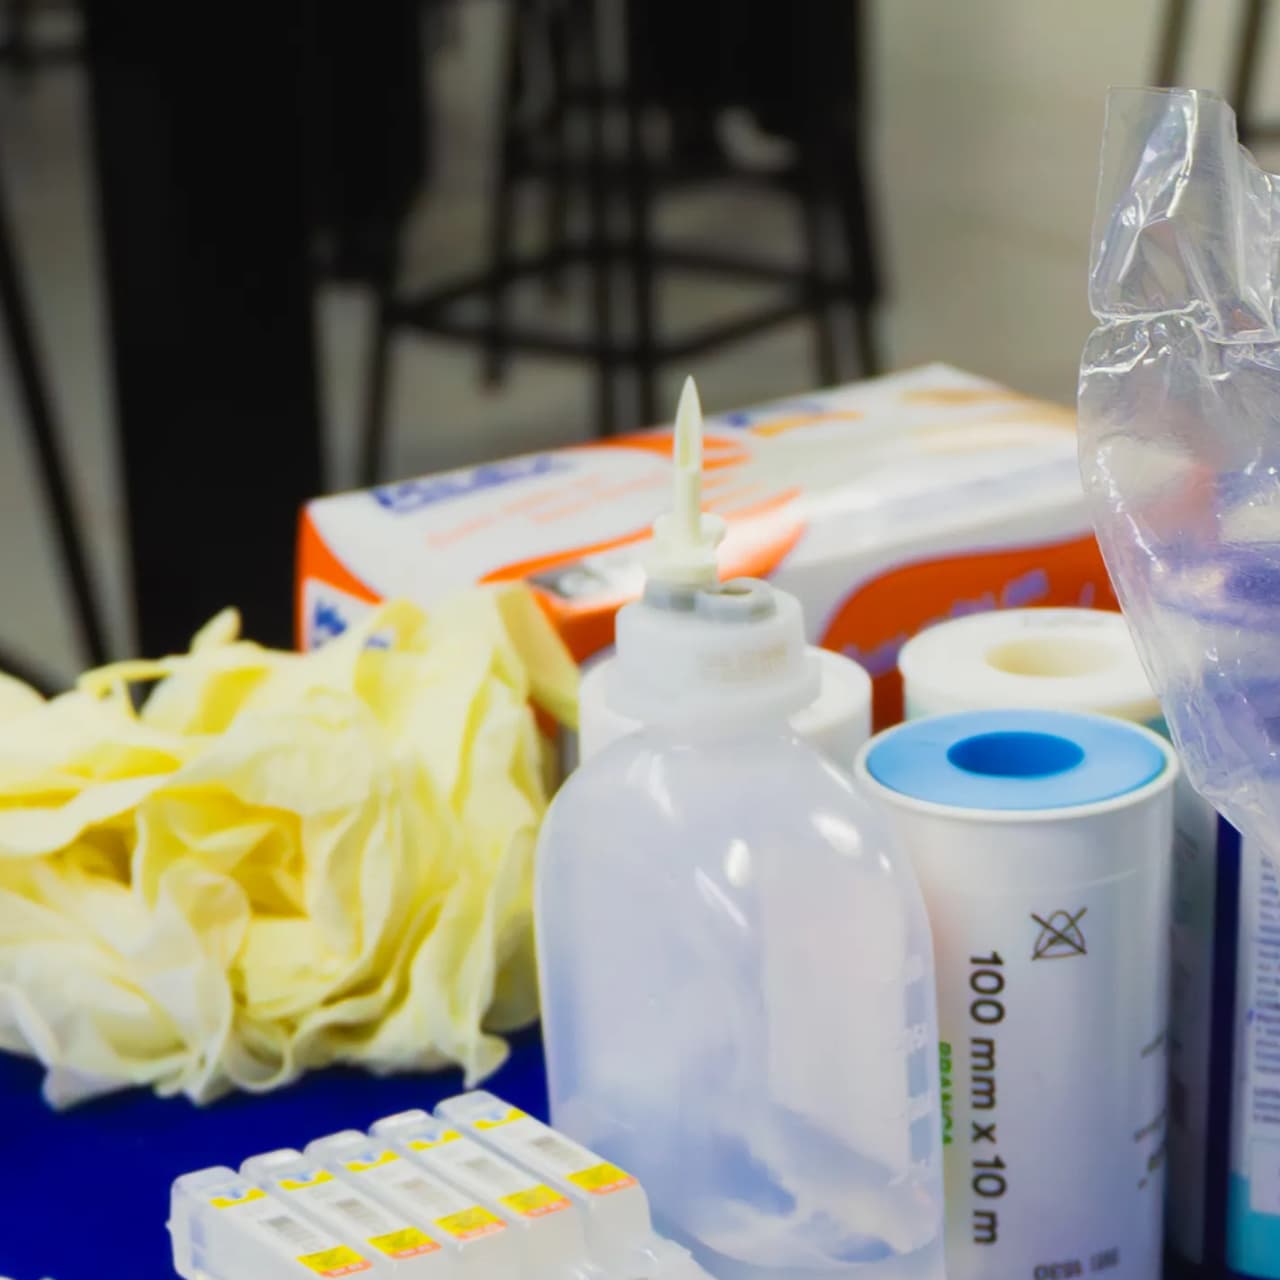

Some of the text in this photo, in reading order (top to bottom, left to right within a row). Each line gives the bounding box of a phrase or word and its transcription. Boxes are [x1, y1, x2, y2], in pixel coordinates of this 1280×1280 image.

[969, 950, 1007, 1246] 100 mm x 10 m
